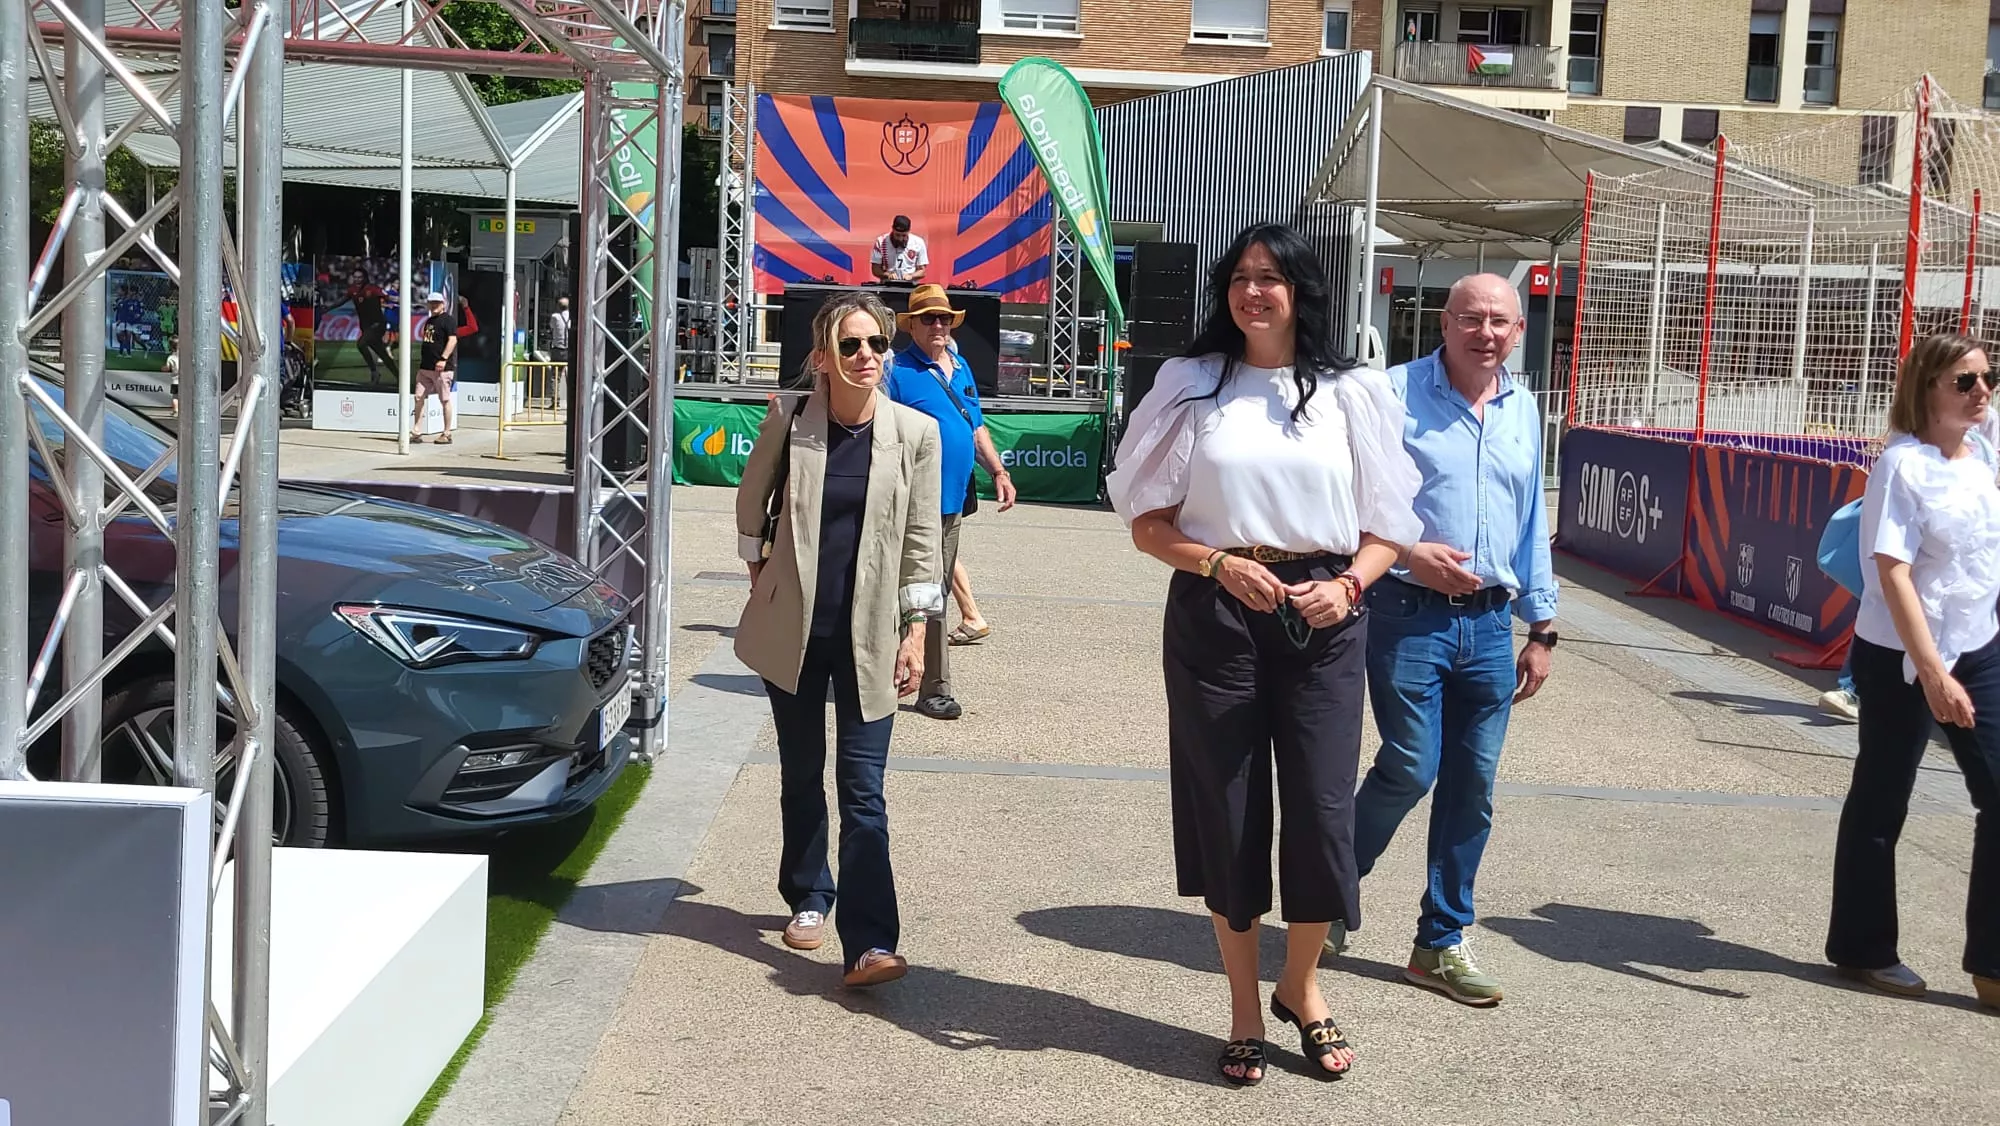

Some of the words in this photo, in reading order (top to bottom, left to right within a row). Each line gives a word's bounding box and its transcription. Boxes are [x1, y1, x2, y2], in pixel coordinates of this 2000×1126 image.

[495, 221, 532, 232] OCE
[111, 383, 122, 391] LA
[125, 383, 164, 393] ESTRELLA
[479, 395, 499, 404] VIAJE
[387, 408, 398, 417] EL
[1001, 444, 1087, 467] erdrola
[1742, 459, 1814, 530] FINAL
